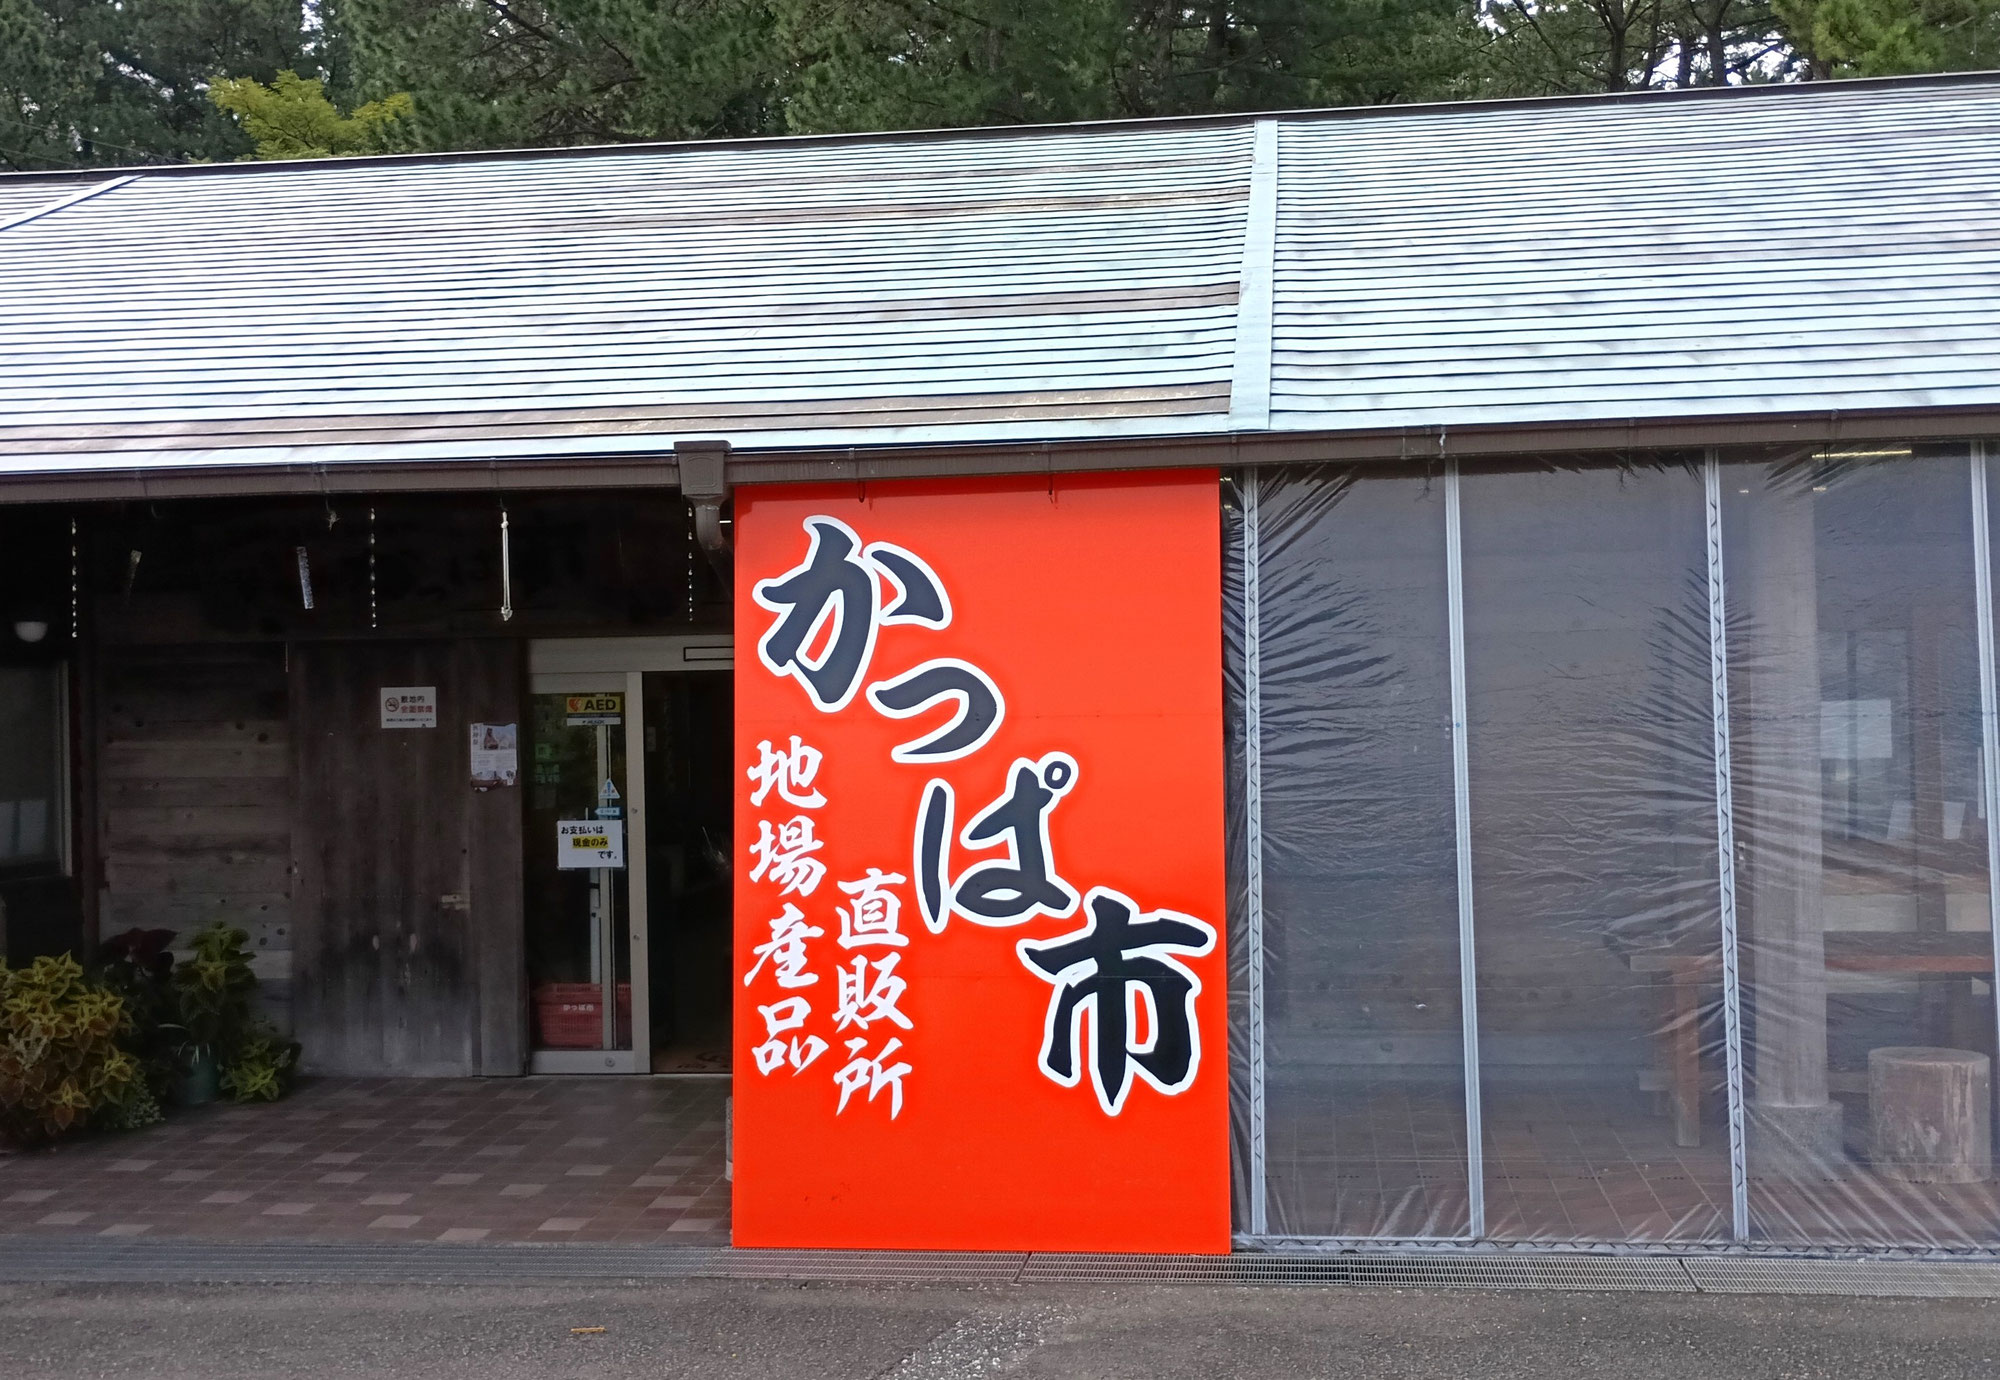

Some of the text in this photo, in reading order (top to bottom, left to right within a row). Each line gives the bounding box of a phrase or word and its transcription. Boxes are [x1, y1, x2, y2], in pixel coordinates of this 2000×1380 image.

[584, 699, 617, 711] AED
[561, 825, 604, 835] お支払いは
[572, 838, 608, 847] 現金のみ
[753, 515, 1217, 1117] かっぱ市
[745, 736, 829, 1078] 地場産品
[834, 868, 914, 1121] 直販所
